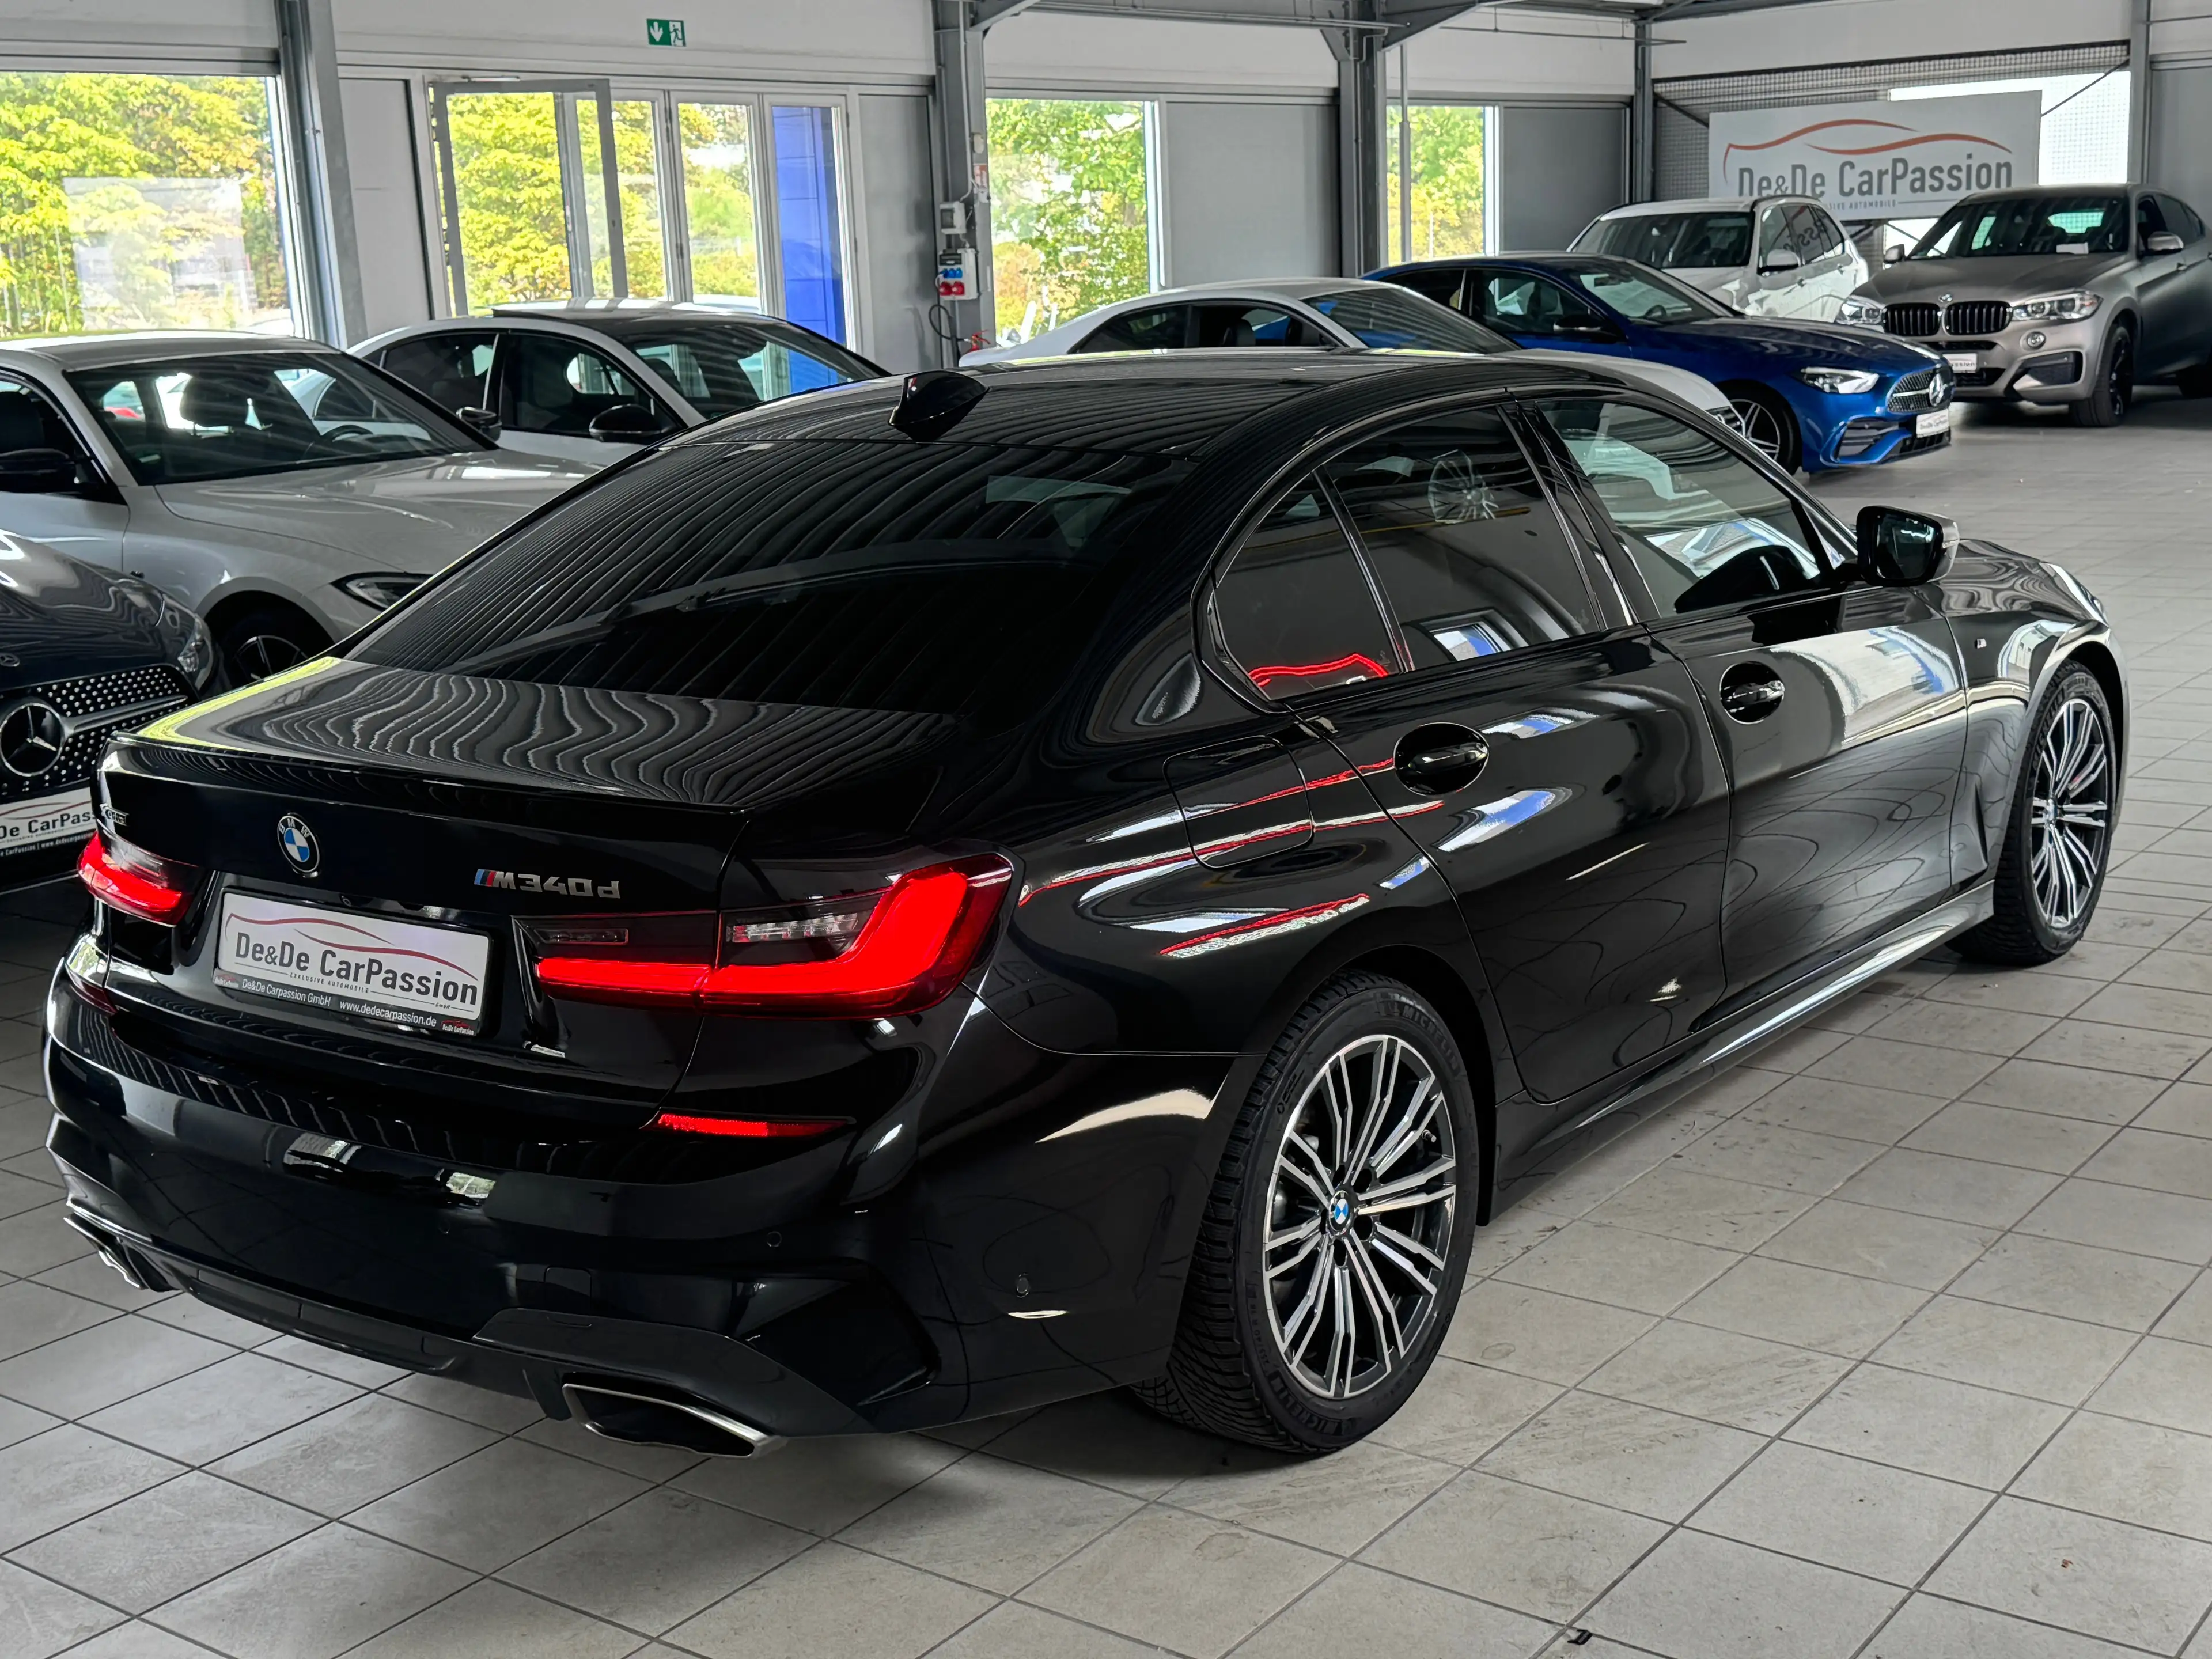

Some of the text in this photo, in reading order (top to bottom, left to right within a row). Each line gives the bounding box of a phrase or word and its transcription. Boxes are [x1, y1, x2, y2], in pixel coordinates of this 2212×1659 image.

[1738, 153, 2012, 198] De&De CarPassion
[493, 870, 621, 899] M340d
[235, 931, 478, 1006] De&De CarPassion
[290, 972, 369, 994] EXKLUSIVE AUTOMOBILE
[242, 978, 266, 993] De&De
[267, 984, 306, 1002] Carpassion
[308, 993, 332, 1007] GmbH
[340, 1001, 437, 1027] www.dedecarpassion.de
